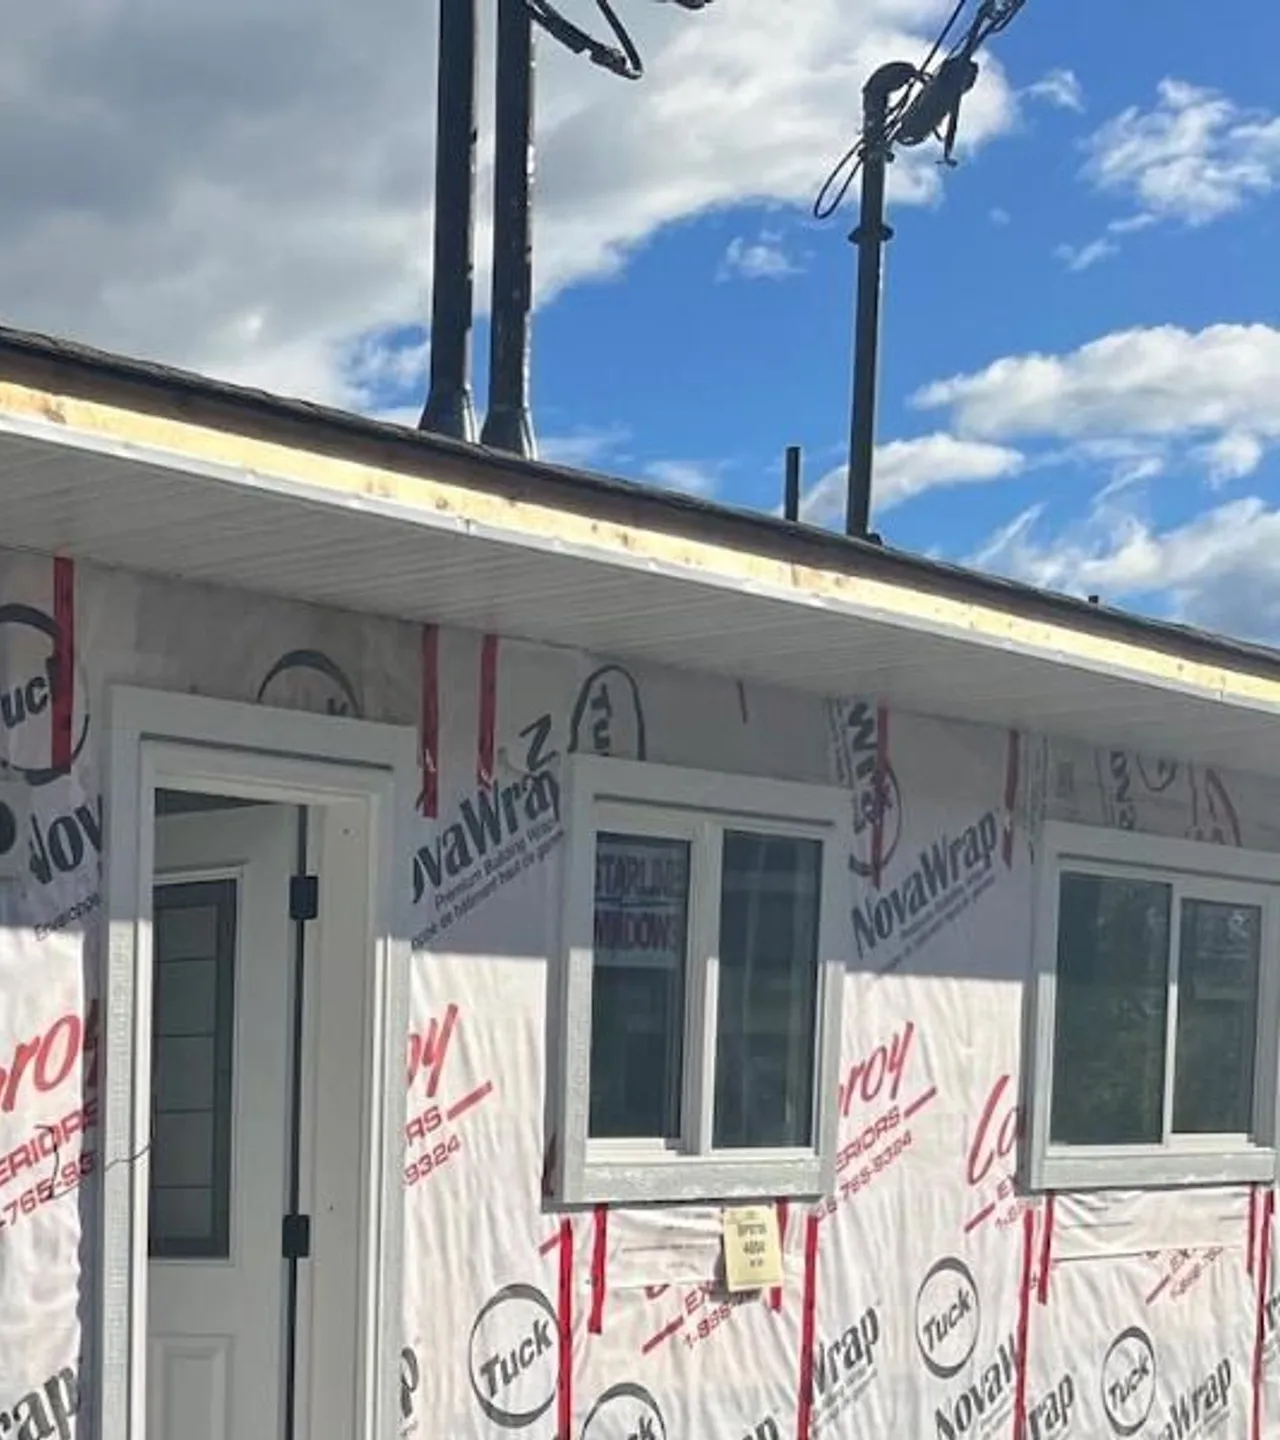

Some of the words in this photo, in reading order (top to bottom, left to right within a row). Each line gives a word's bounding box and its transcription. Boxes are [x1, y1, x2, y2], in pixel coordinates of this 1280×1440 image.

[851, 810, 999, 961] NovaWrap
[922, 1286, 973, 1355] Tuck
[480, 1318, 554, 1398] Tuck
[1107, 1353, 1152, 1411] Tuck
